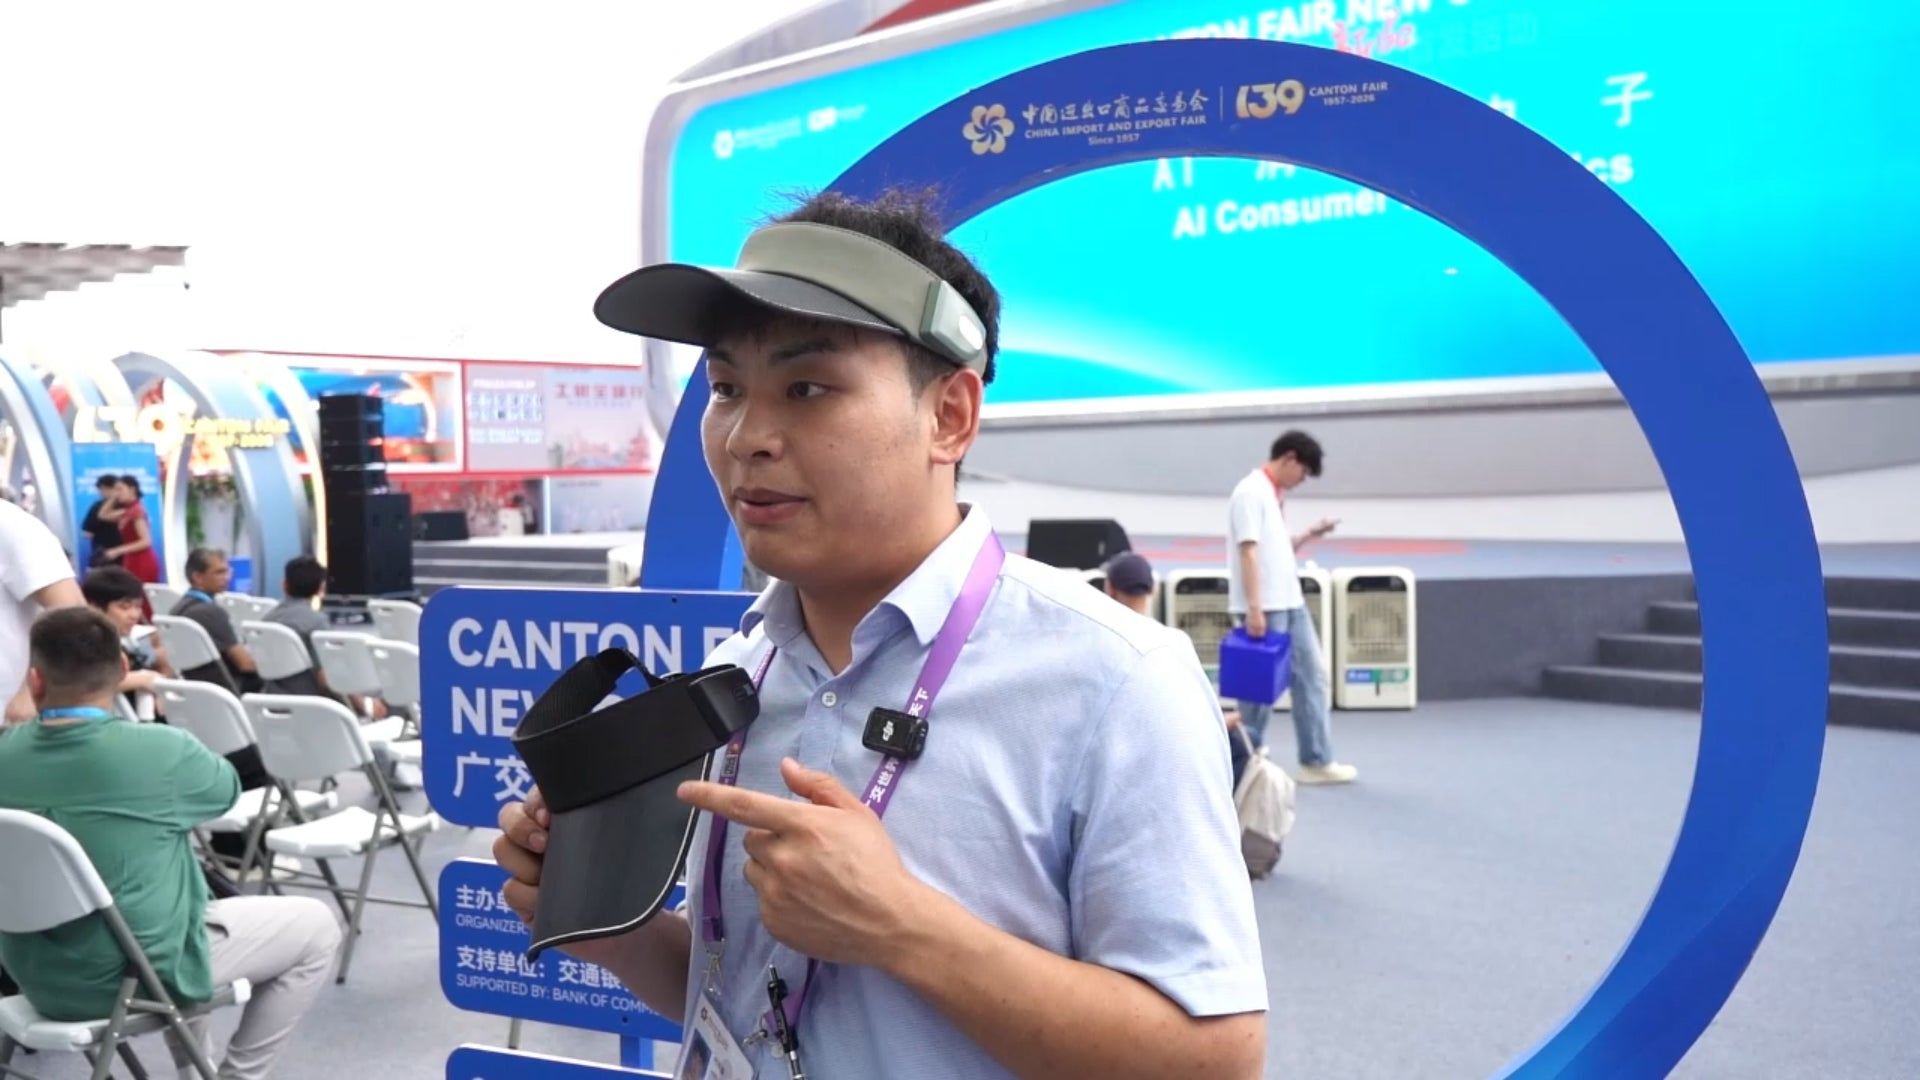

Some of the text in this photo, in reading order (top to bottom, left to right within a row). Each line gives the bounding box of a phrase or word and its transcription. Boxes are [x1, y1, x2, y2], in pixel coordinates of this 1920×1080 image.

[1236, 79, 1305, 119] 139
[1309, 81, 1388, 97] CANTON FAIR
[1025, 115, 1207, 139] CHINA IMPORT AND EXPORT FAIR
[1088, 133, 1140, 146] Since 1957
[1173, 204, 1206, 240] AI
[1215, 190, 1387, 234] Consumer
[448, 617, 683, 675] CANTON
[451, 686, 535, 737] NE
[453, 751, 532, 801] 广交
[456, 973, 528, 996] SUPPORTED
[531, 984, 550, 999] BY:
[552, 987, 588, 1005] BANK
[590, 993, 609, 1007] OF
[558, 959, 629, 992] 交通银
